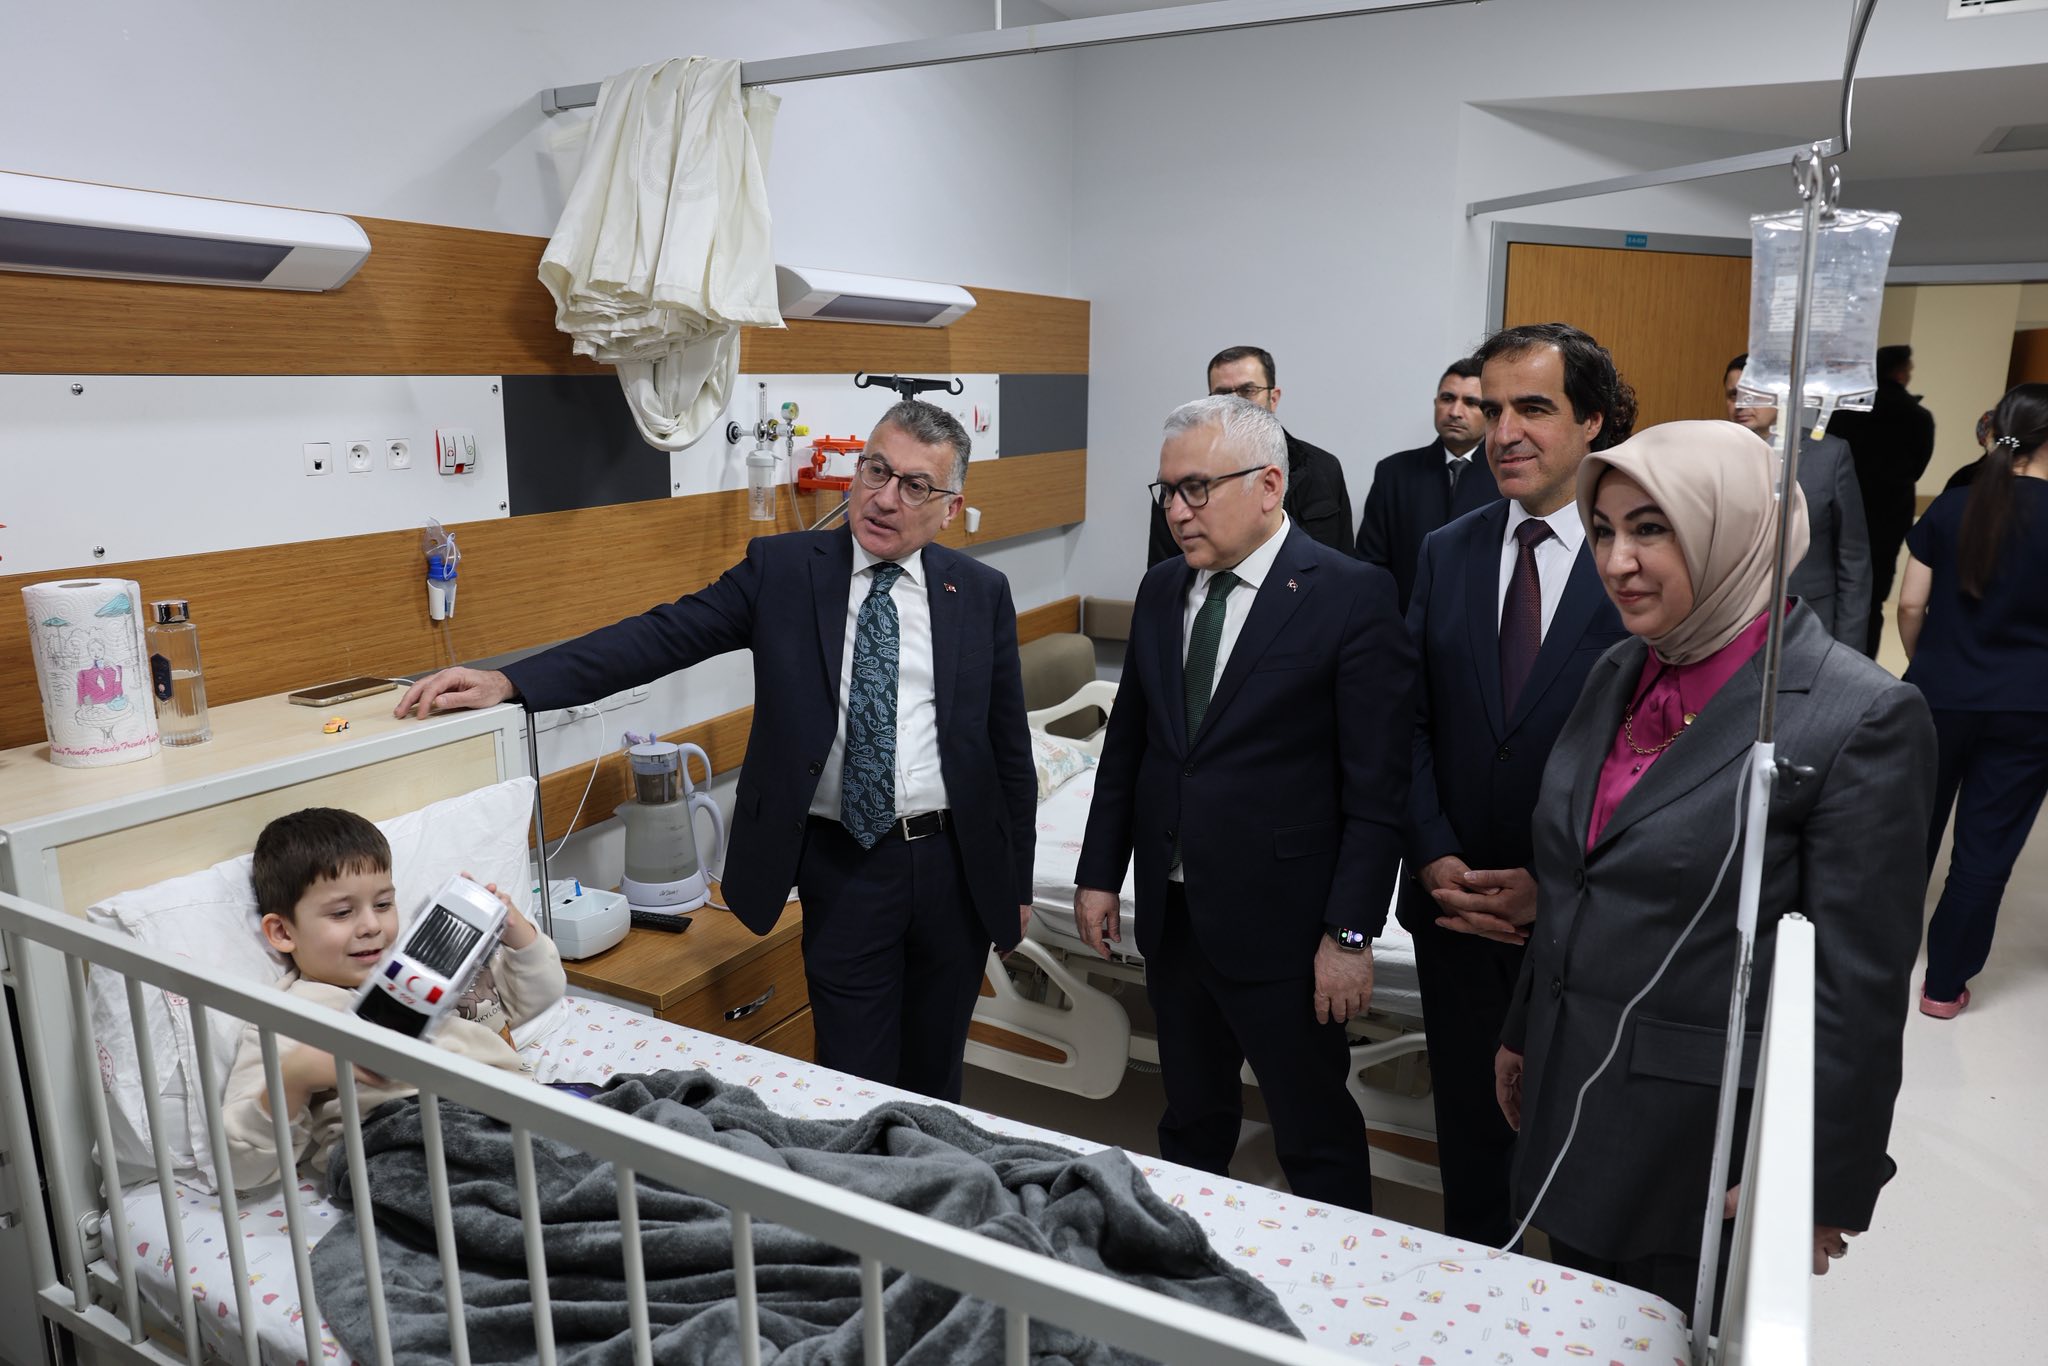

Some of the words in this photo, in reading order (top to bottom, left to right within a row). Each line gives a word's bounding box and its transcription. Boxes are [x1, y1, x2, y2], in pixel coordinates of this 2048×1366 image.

[65, 747, 90, 756] Trendy
[89, 745, 120, 755] Trendy
[120, 738, 147, 749] Trendy
[474, 1005, 501, 1023] NKYLOS
